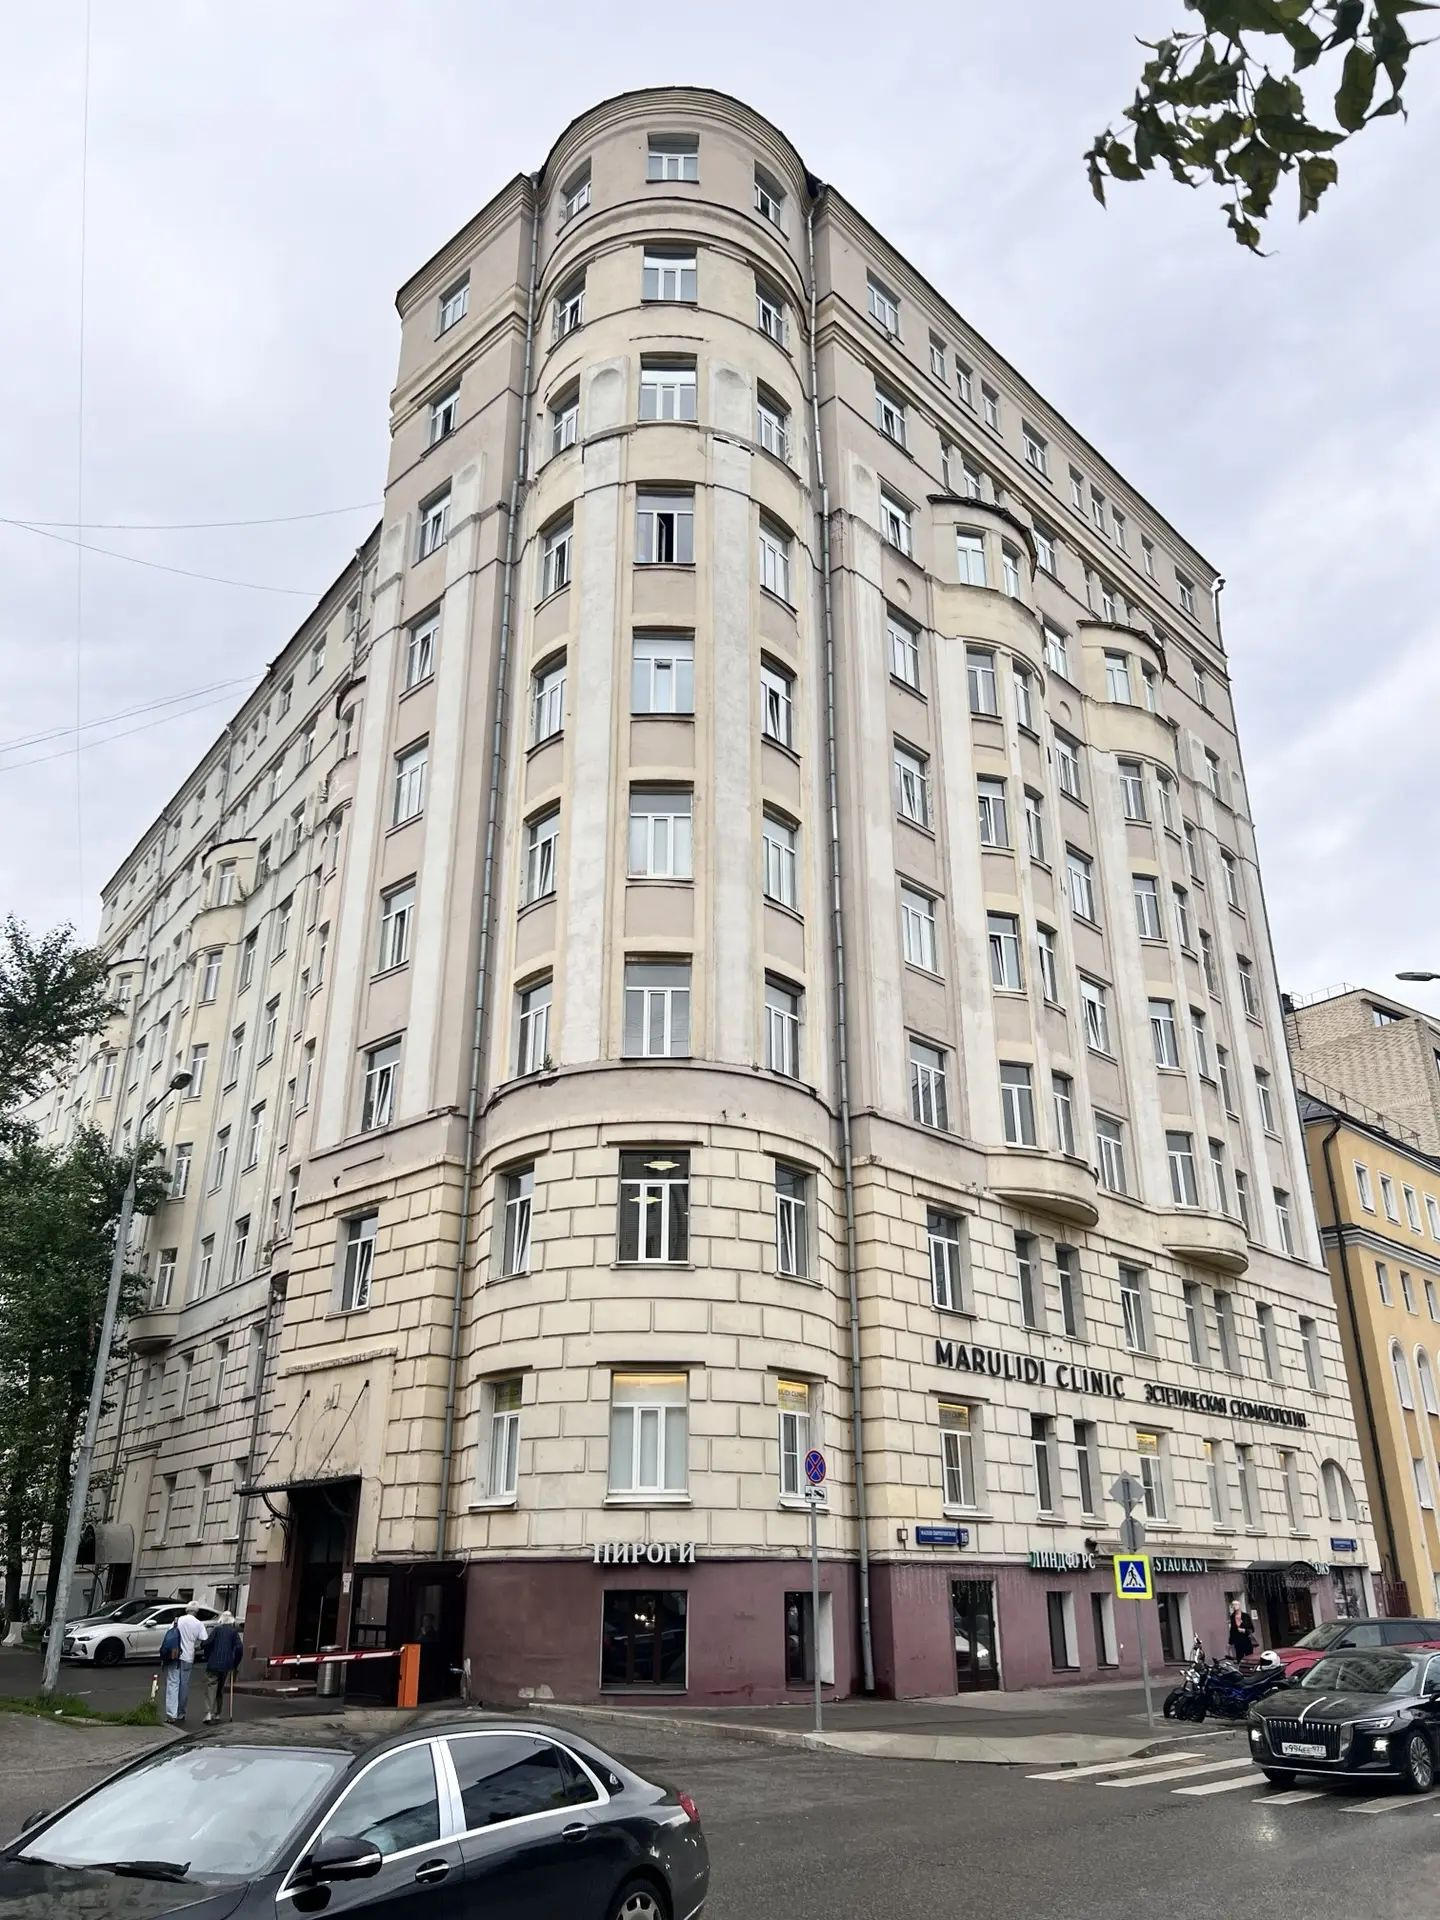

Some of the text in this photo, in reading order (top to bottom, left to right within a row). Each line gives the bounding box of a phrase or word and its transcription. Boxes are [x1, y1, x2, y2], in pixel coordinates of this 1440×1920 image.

[935, 1339, 1126, 1398] MARULIDI CLINIC
[1144, 1383, 1307, 1428] ЭСТЕТИЧЕСКАЯ СТОМАТОЛОГИЯ
[592, 1543, 696, 1564] ПИРОГИ
[1153, 1557, 1208, 1573] STAURANT
